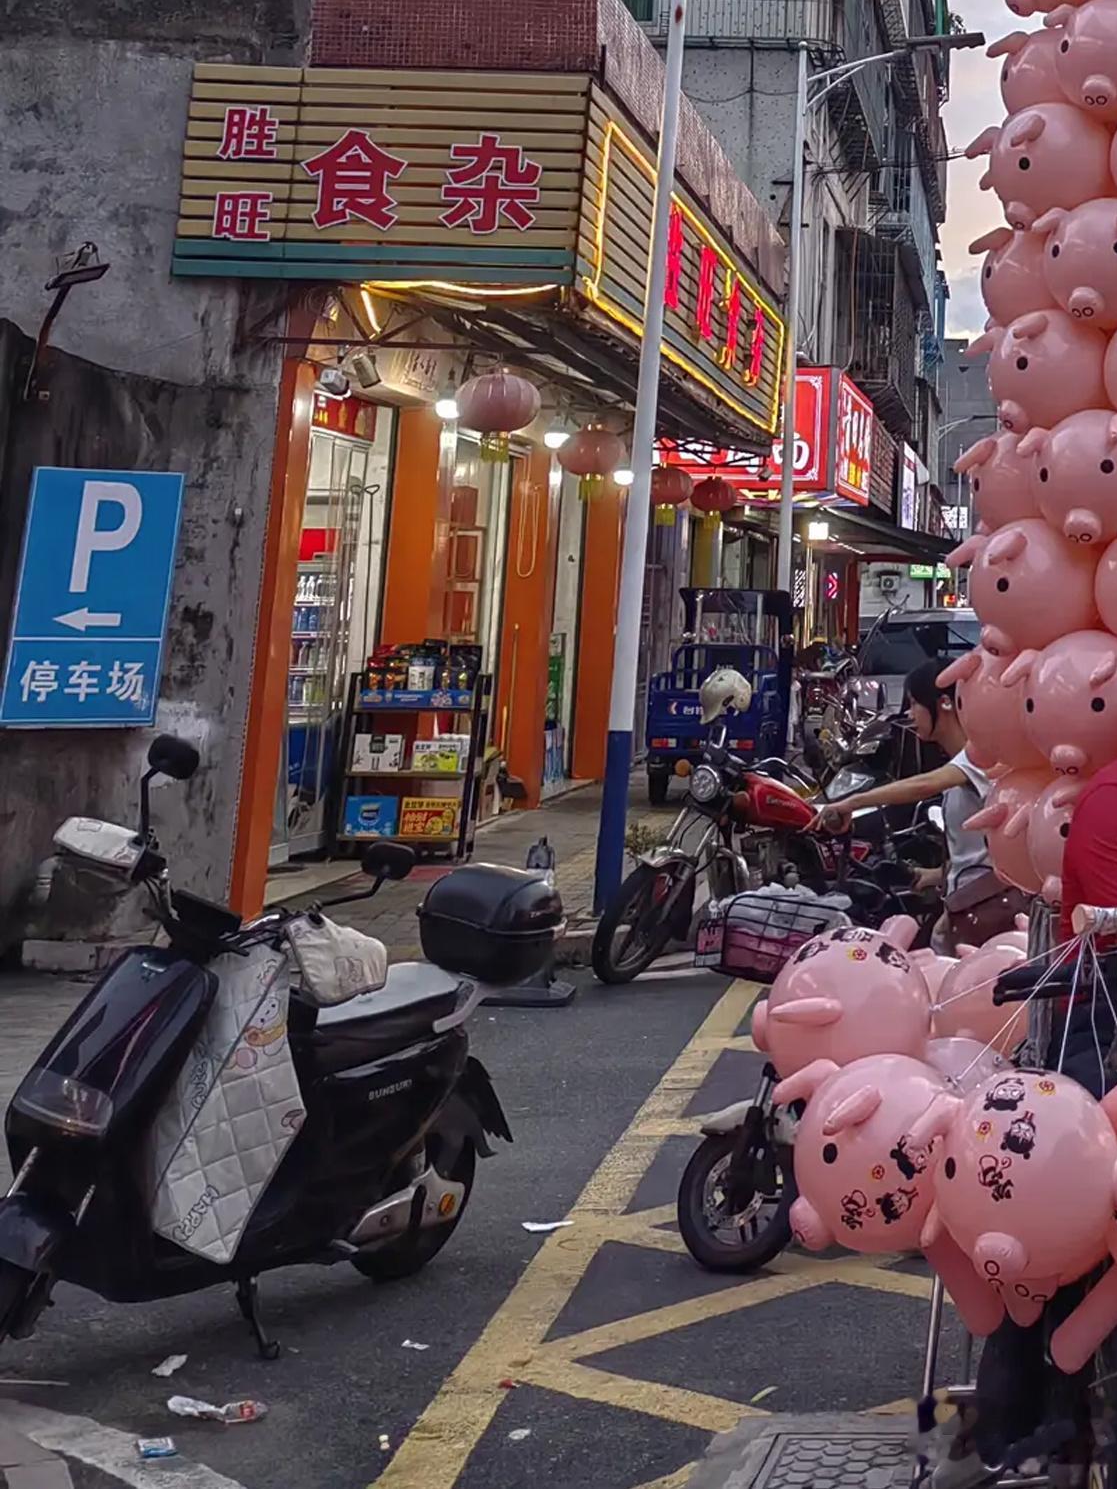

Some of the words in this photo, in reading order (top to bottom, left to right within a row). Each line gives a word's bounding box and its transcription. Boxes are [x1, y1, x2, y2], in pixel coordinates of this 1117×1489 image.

[212, 105, 279, 243] 胜旺
[301, 127, 543, 235] 食杂
[69, 480, 143, 593] P
[20, 661, 144, 703] 停车场
